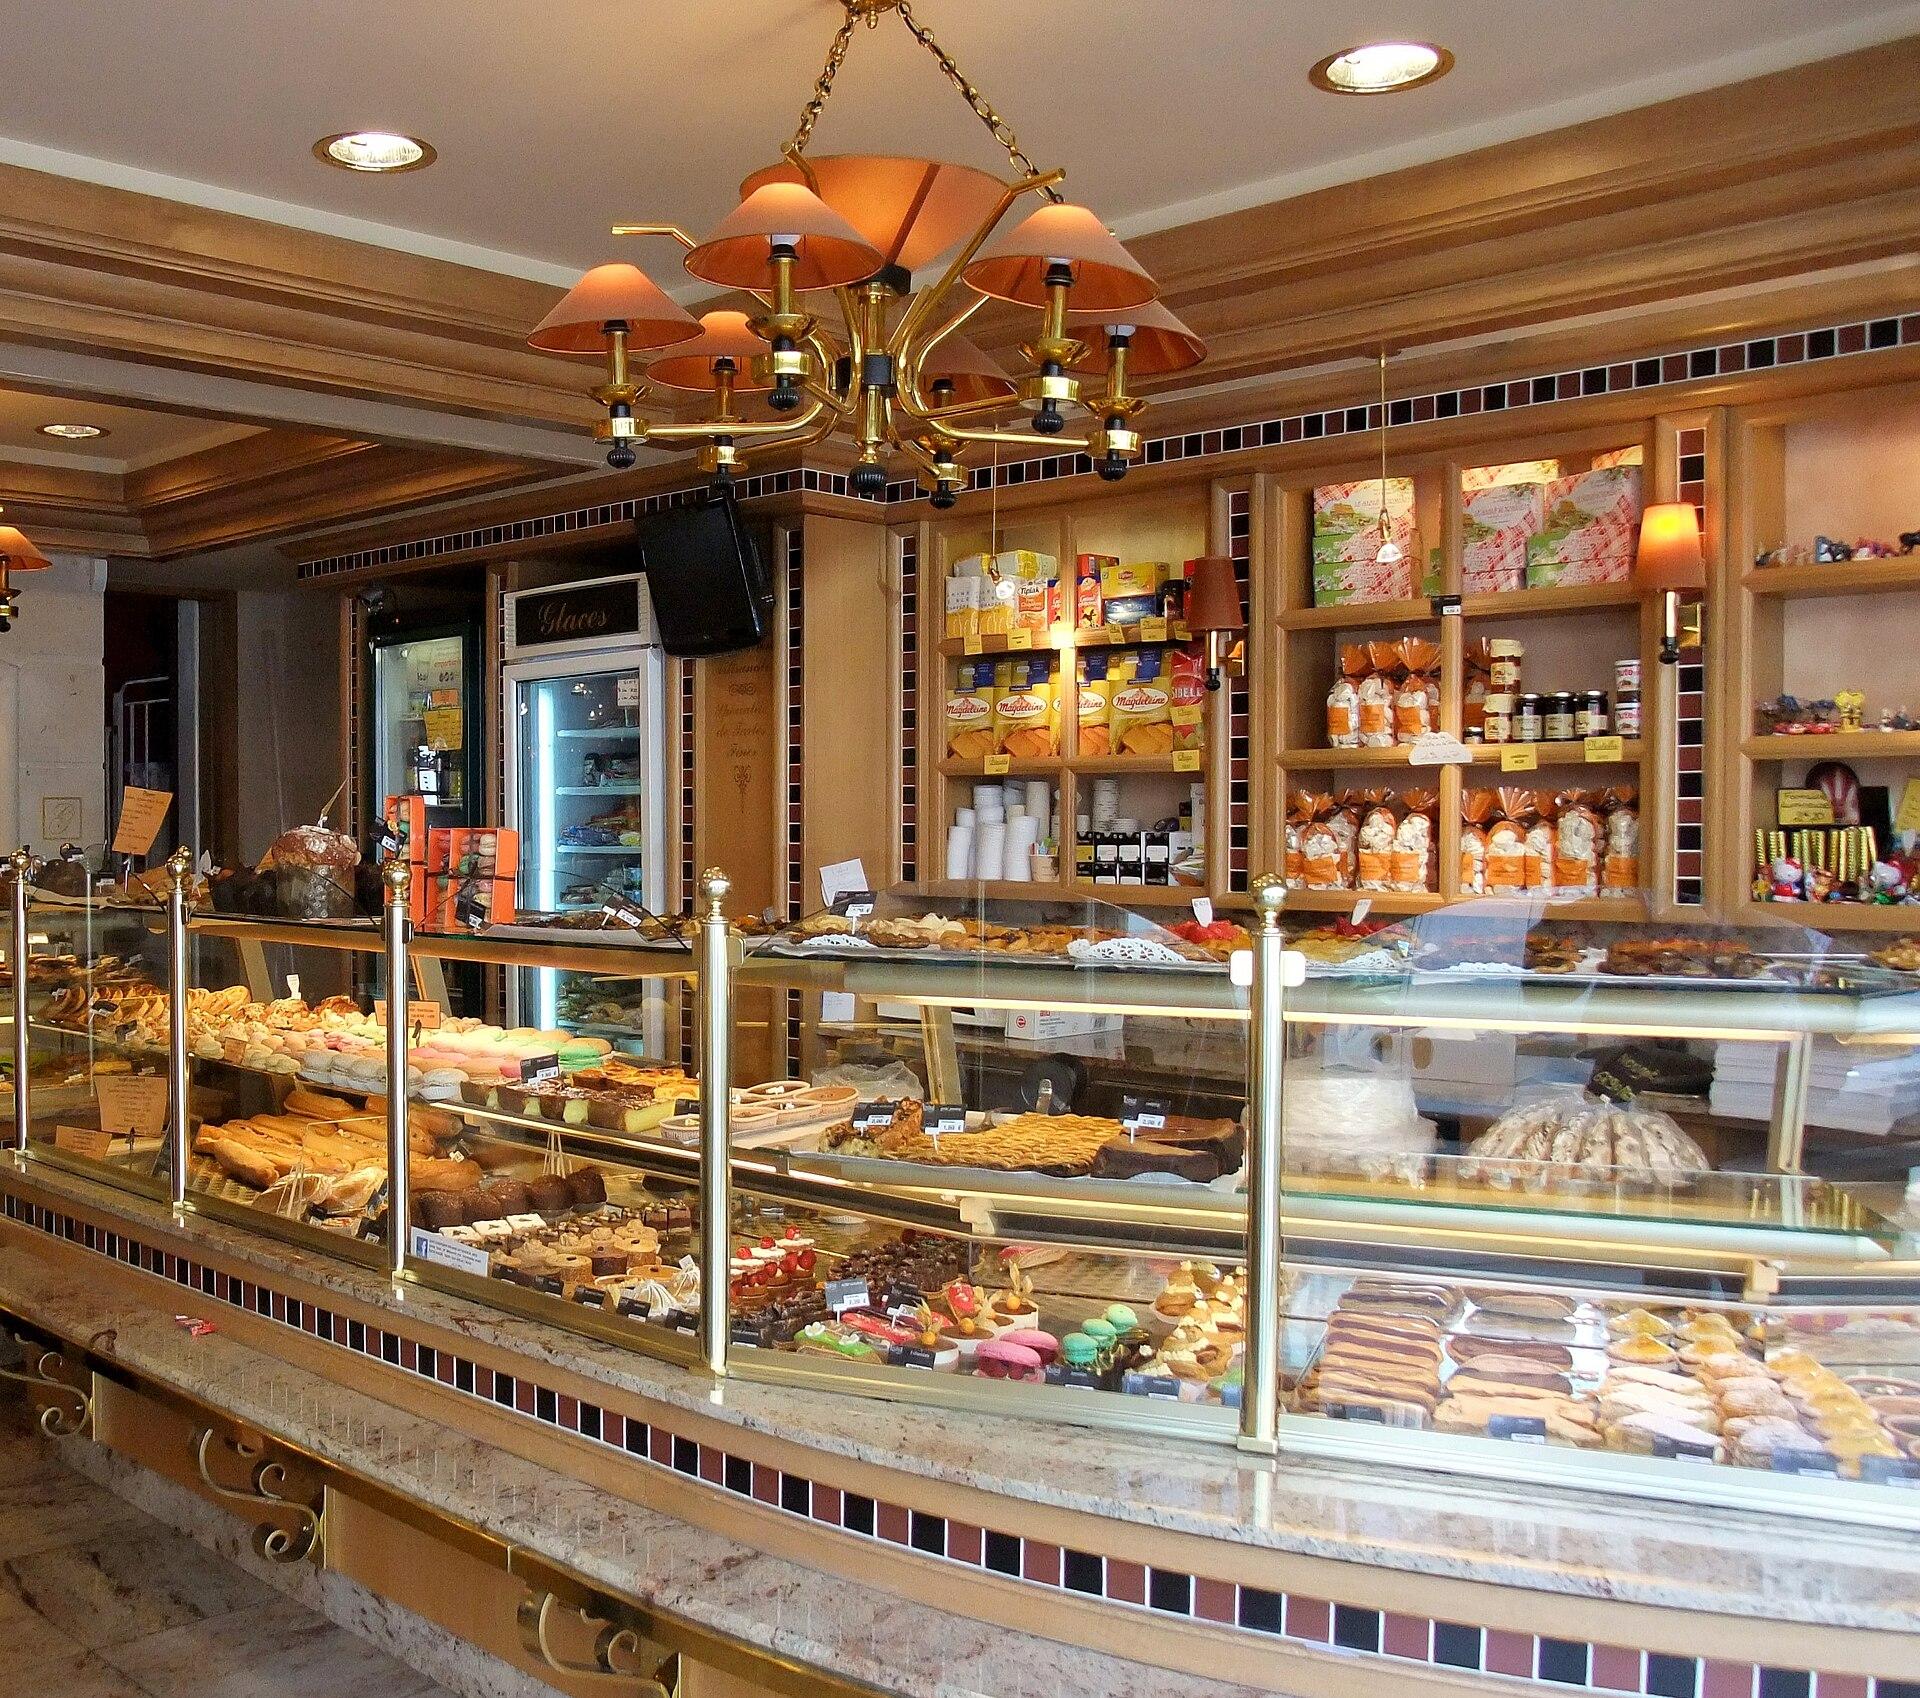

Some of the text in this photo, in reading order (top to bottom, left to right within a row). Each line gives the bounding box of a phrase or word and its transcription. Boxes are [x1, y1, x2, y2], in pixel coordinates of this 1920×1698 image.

[539, 601, 608, 635] Glaces
[946, 703, 988, 717] Magdeleine
[999, 702, 1043, 717] Magdeleine
[1116, 696, 1166, 710] Magdeleine
